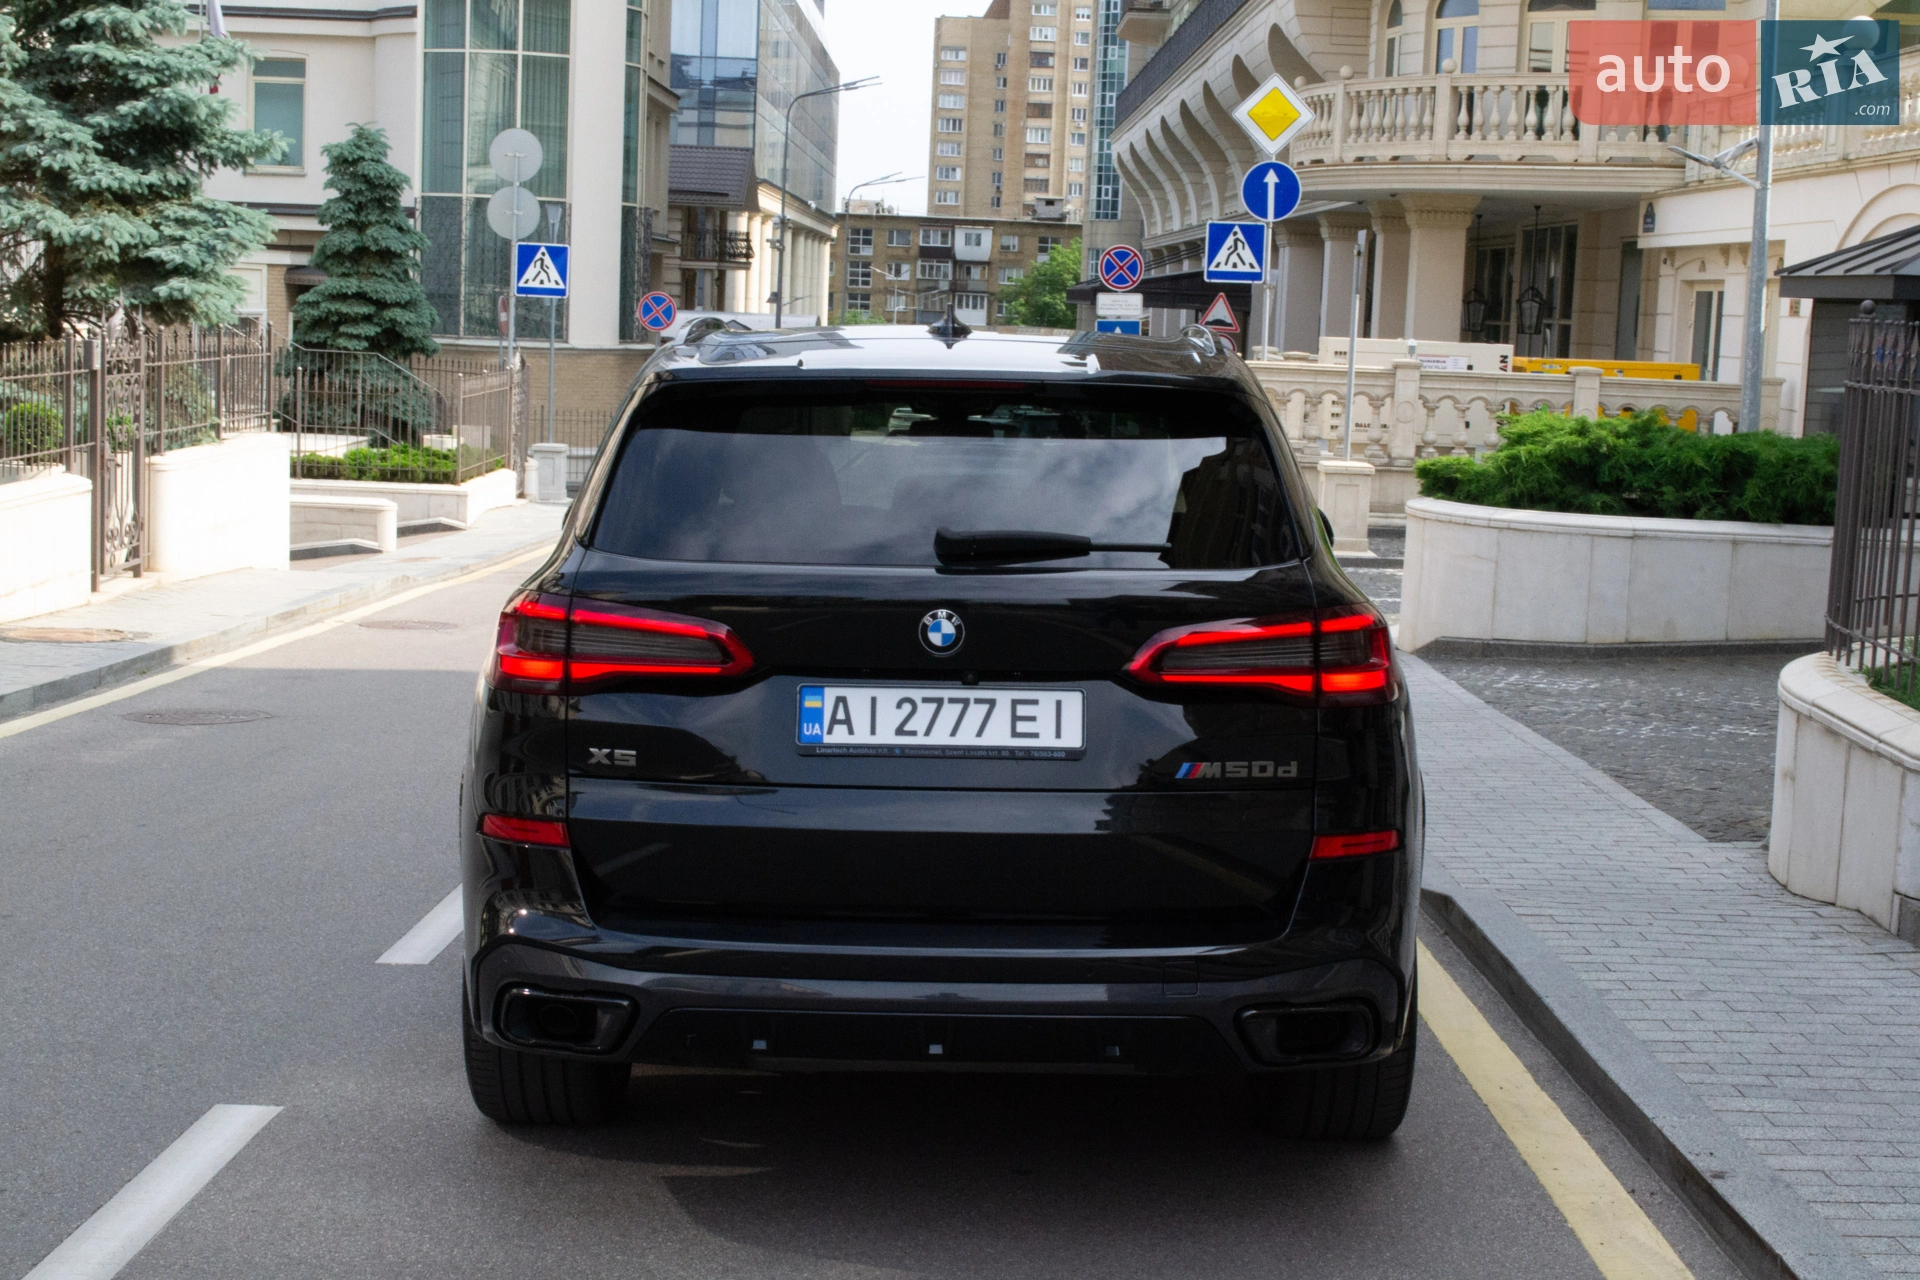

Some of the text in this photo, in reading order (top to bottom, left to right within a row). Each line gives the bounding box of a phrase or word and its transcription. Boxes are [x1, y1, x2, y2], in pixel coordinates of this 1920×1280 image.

[923, 611, 962, 626] BMW
[803, 723, 822, 736] UA
[587, 747, 637, 767] X5
[1195, 760, 1298, 779] M50d
